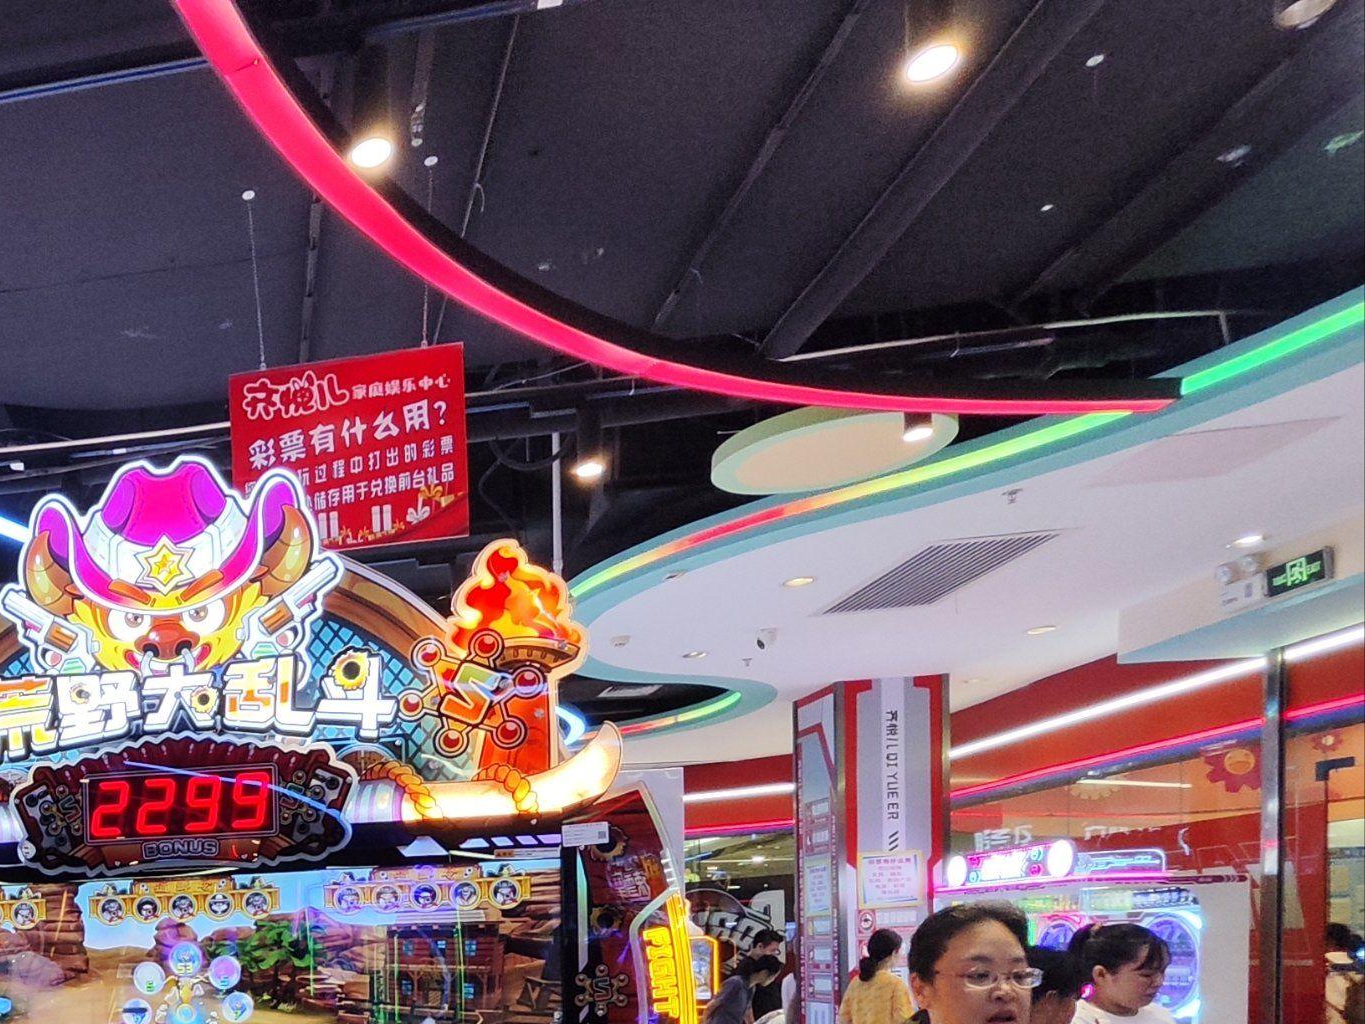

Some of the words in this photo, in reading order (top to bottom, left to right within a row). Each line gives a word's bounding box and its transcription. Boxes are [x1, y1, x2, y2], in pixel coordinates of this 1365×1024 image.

[352, 373, 451, 400] 家庭娱乐中心
[306, 462, 455, 513] 储存用于兑换前台礼品
[89, 771, 269, 839] 2299
[144, 840, 220, 859] BONUS
